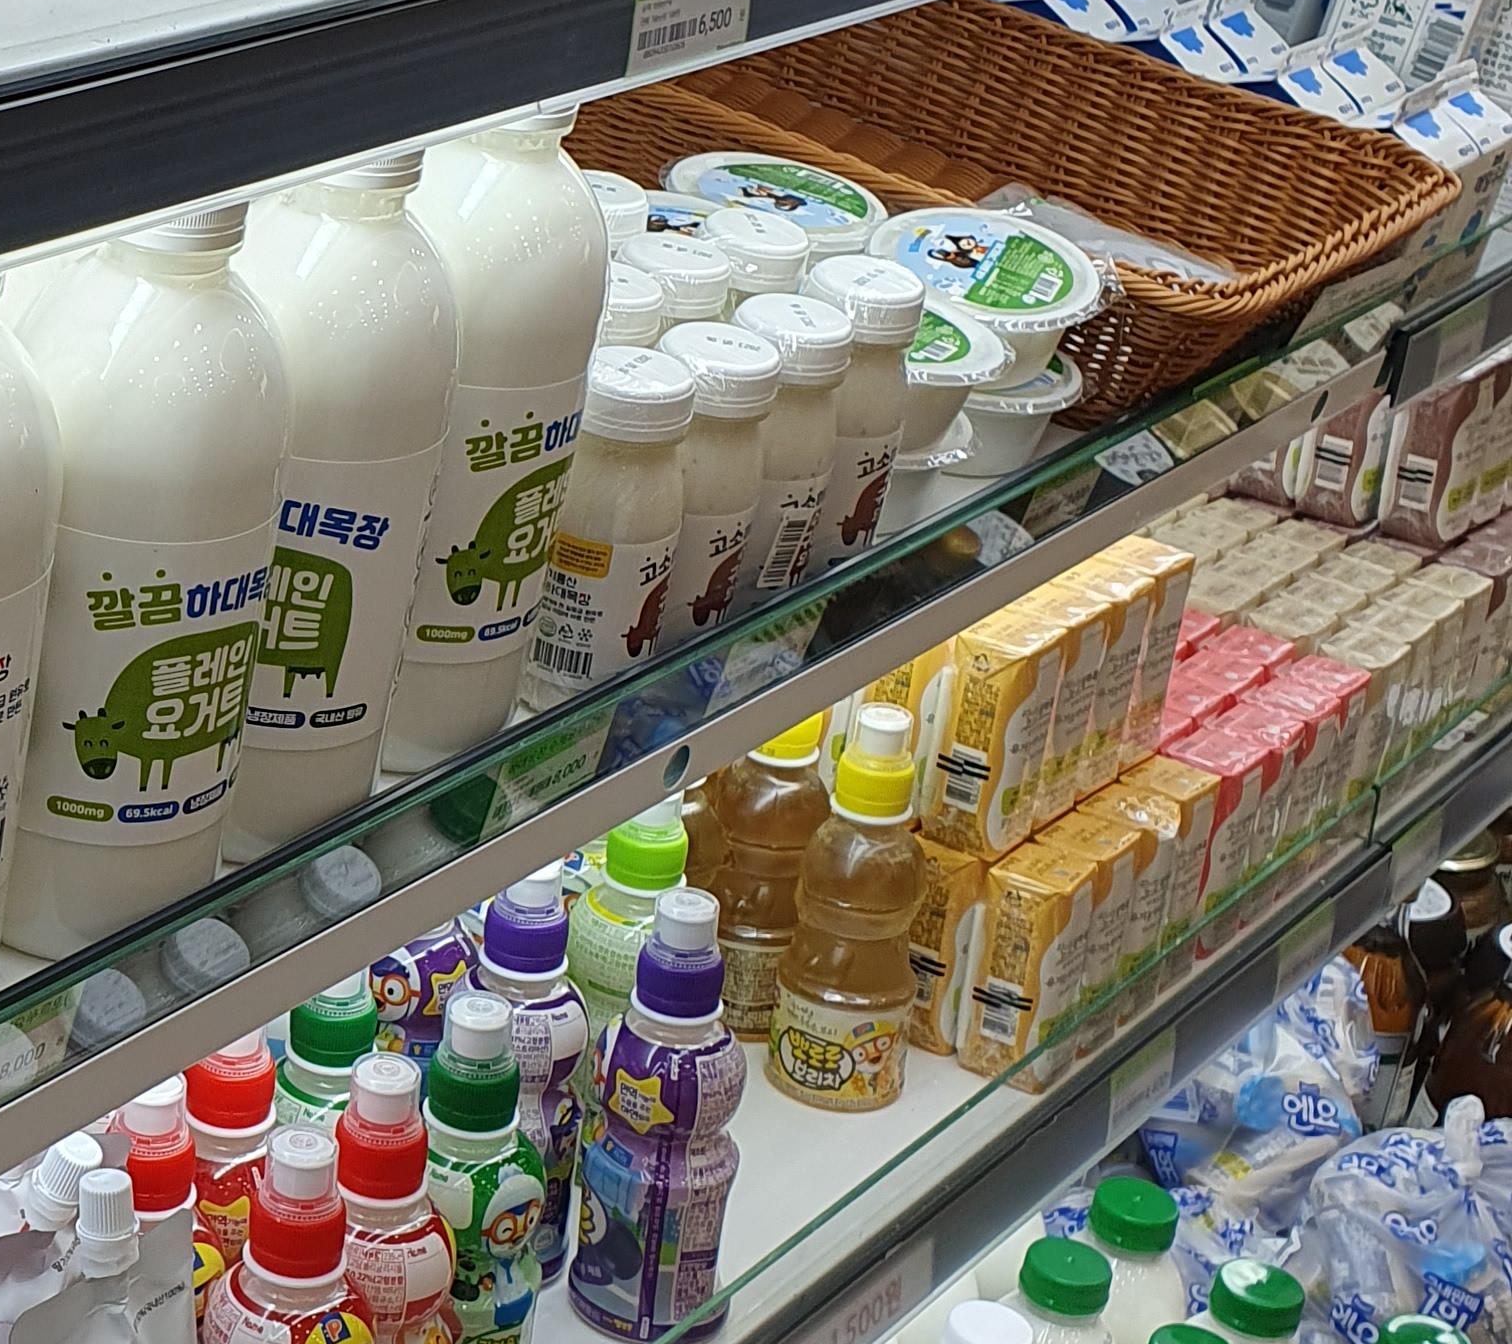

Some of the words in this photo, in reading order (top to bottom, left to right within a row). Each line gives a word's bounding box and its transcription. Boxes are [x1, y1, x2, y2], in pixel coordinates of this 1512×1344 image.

[698, 7, 732, 36] 6,500
[87, 568, 183, 630] 깔끔
[424, 626, 468, 641] 1000mg
[151, 634, 254, 696] 플레인
[142, 680, 244, 740] 요거트
[247, 708, 296, 726] 냉장제품
[315, 712, 344, 724] 국내산
[56, 800, 104, 818] 1000mg
[126, 804, 174, 819] 69.5kcal
[791, 1058, 843, 1090] 보리차
[1283, 1093, 1340, 1135] 엔요
